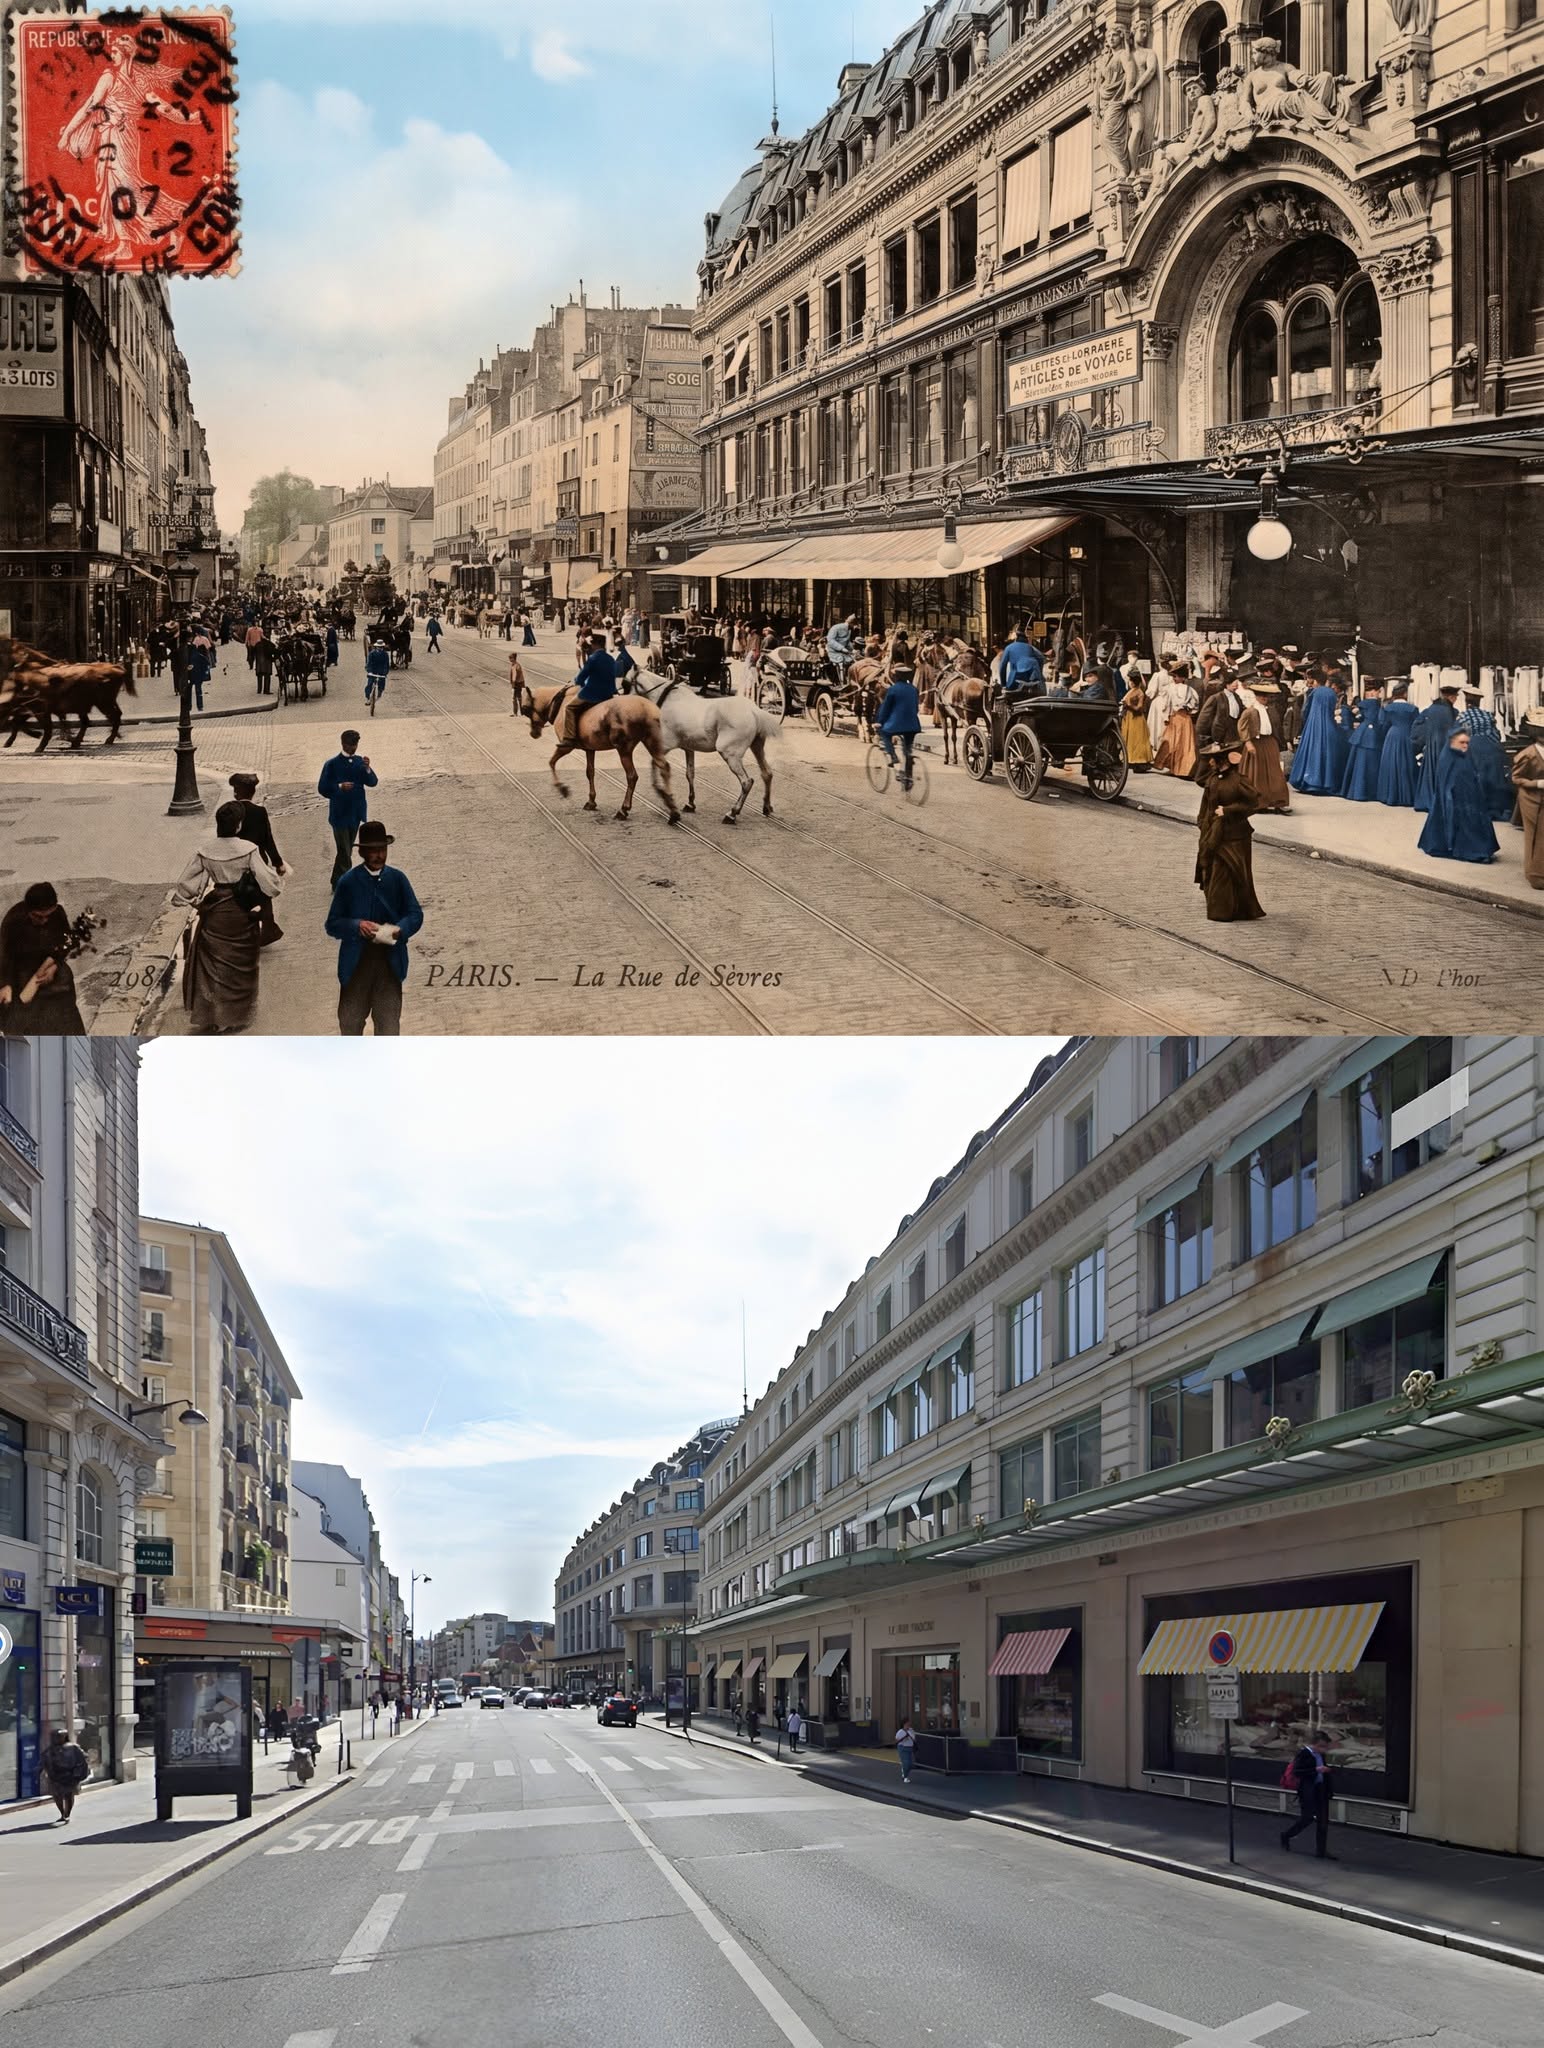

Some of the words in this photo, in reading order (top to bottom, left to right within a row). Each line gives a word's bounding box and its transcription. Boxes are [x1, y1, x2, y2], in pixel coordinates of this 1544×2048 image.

[21, 370, 55, 386] LOTS
[1013, 367, 1065, 392] ARTICLES
[1068, 364, 1081, 377] DE
[1085, 348, 1133, 371] VOYAGE
[263, 1815, 420, 1855] BUS
